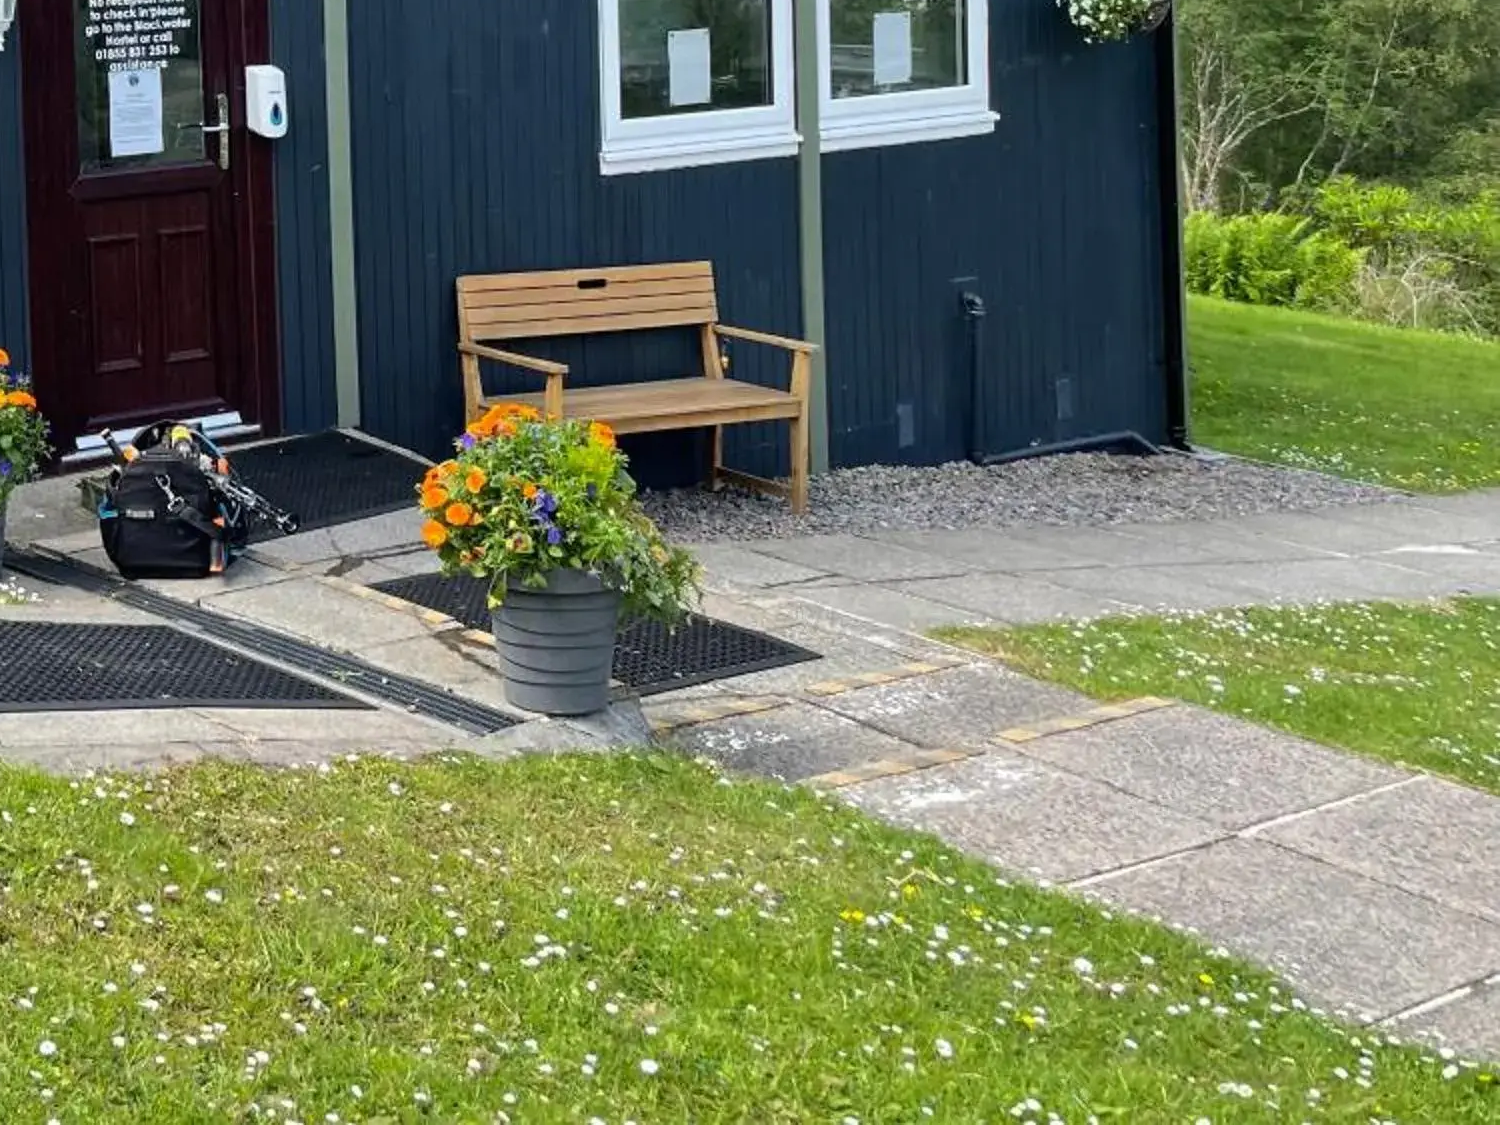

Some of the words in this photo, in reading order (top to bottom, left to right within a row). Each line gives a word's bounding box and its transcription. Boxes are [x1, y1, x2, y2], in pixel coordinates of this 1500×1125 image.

[89, 10, 101, 21] to
[103, 8, 137, 20] check
[138, 6, 149, 18] in
[149, 5, 186, 19] please
[85, 25, 100, 37] go
[101, 22, 113, 34] to
[113, 21, 133, 33] the
[139, 34, 151, 44] or
[152, 31, 173, 43] call
